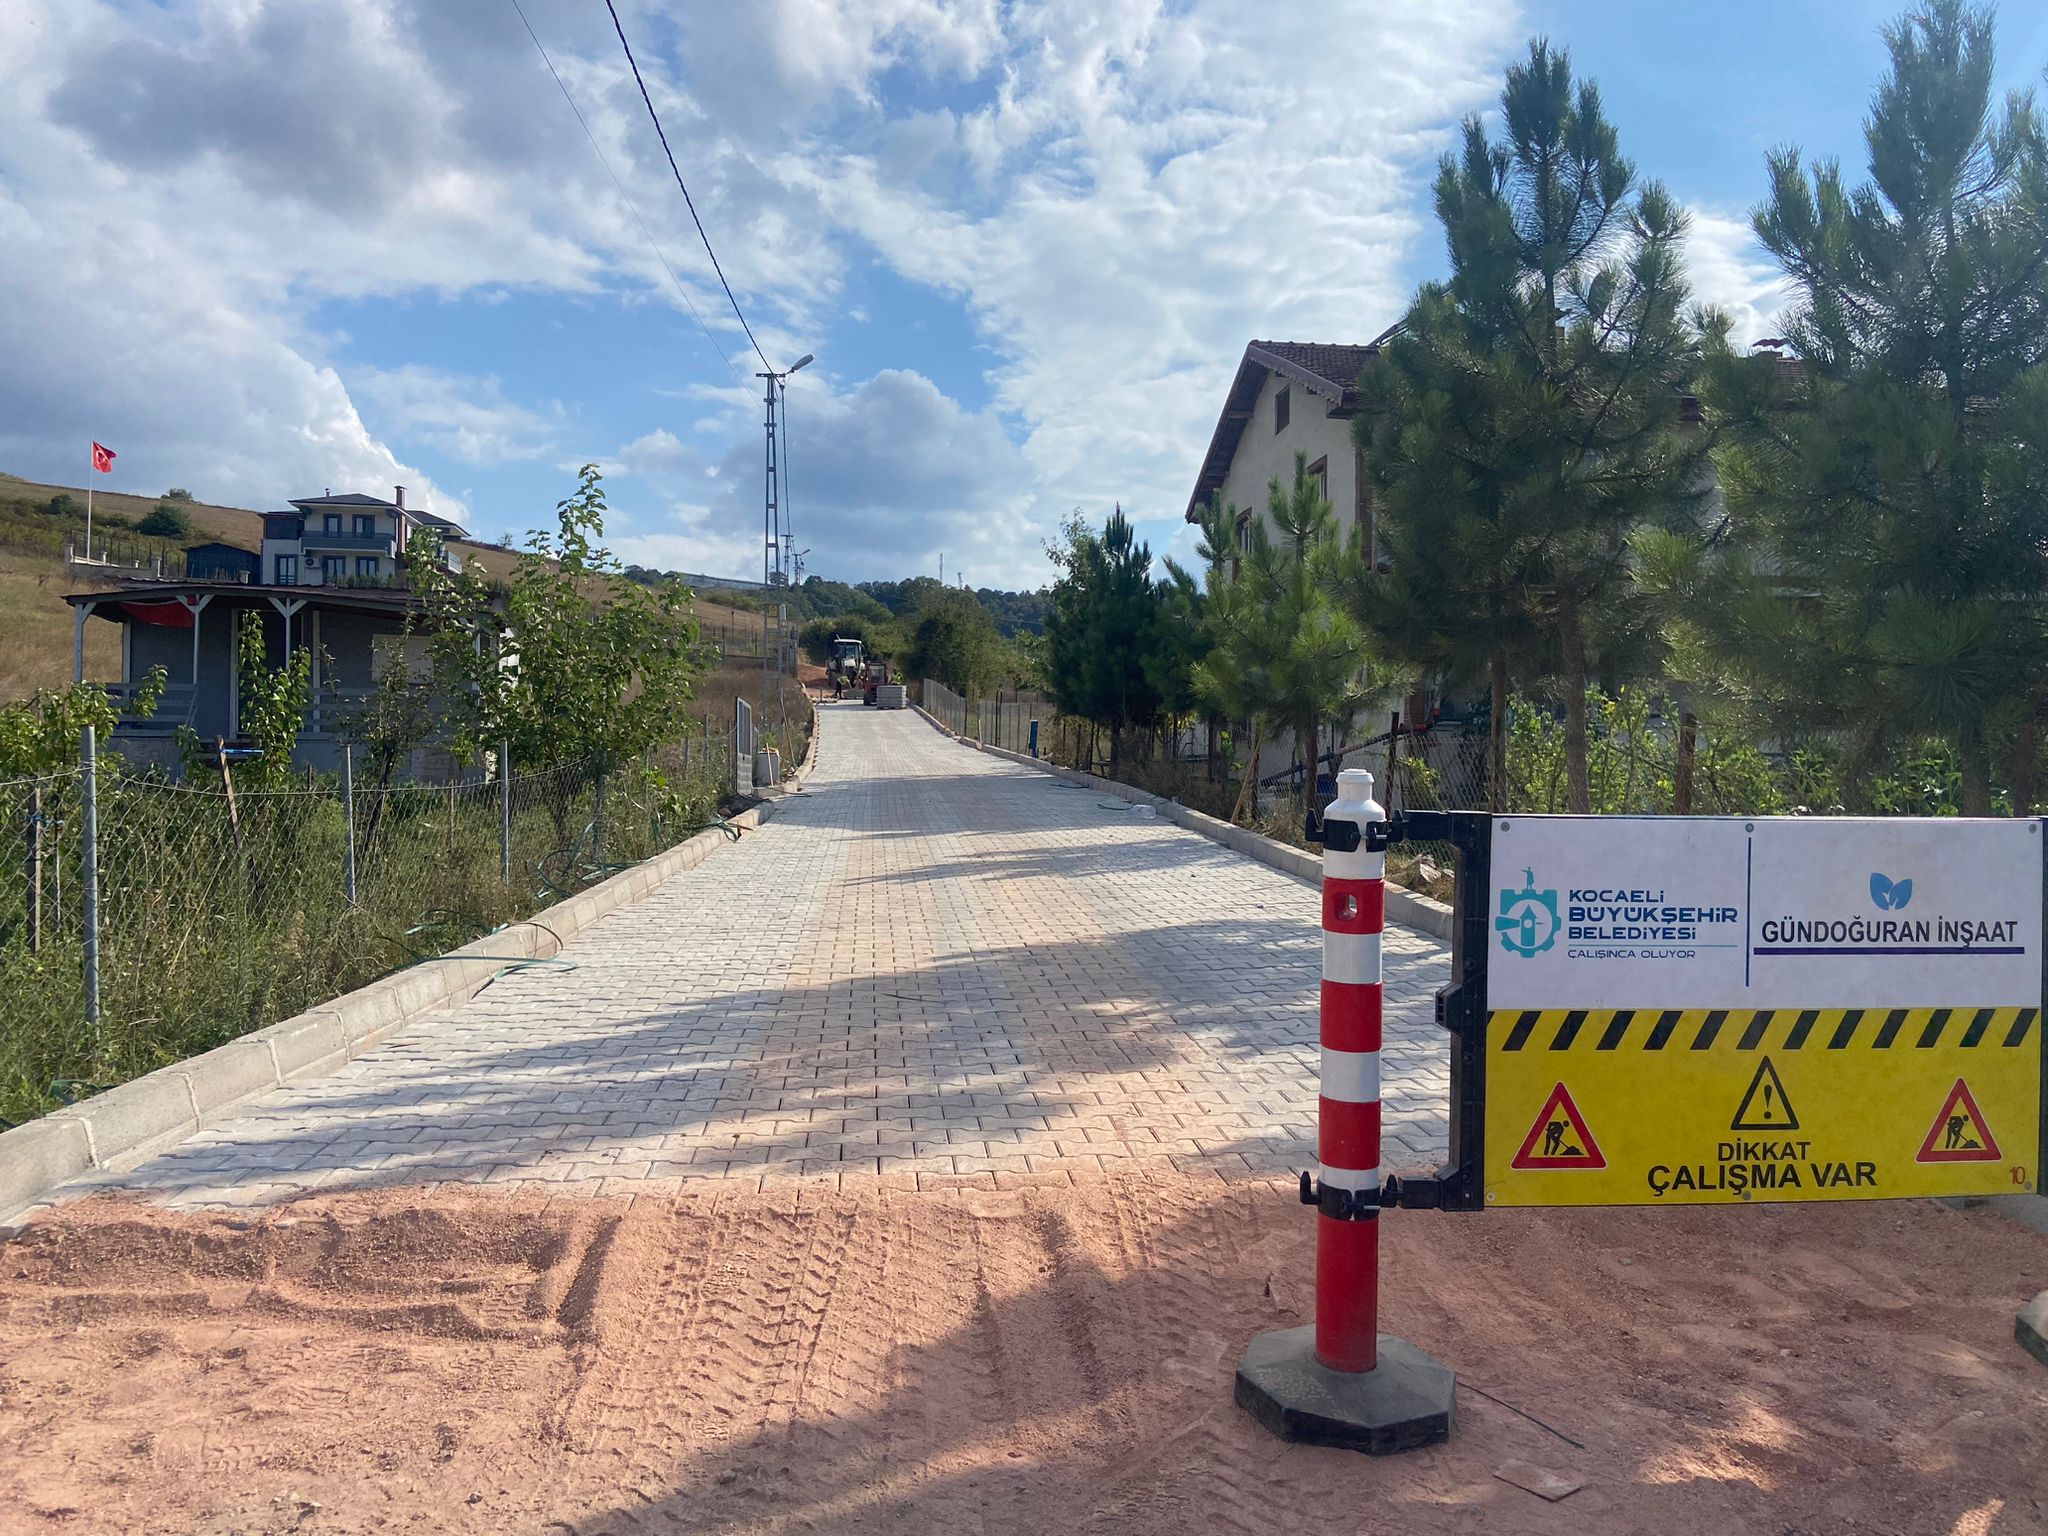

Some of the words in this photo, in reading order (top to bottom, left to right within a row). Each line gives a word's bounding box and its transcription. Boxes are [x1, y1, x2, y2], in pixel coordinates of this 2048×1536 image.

[1761, 915, 1930, 943] GÜNDOĞURAN
[1937, 915, 2018, 948] İNŞAAT
[1567, 949, 1637, 960] ÇALIŞINCA
[1640, 949, 1697, 959] OLUYOR
[1717, 1137, 1812, 1162] DİKKAT
[1647, 1163, 1802, 1196] ÇALIŞMA
[1810, 1161, 1878, 1188] VAR
[2009, 1166, 2026, 1185] 10
